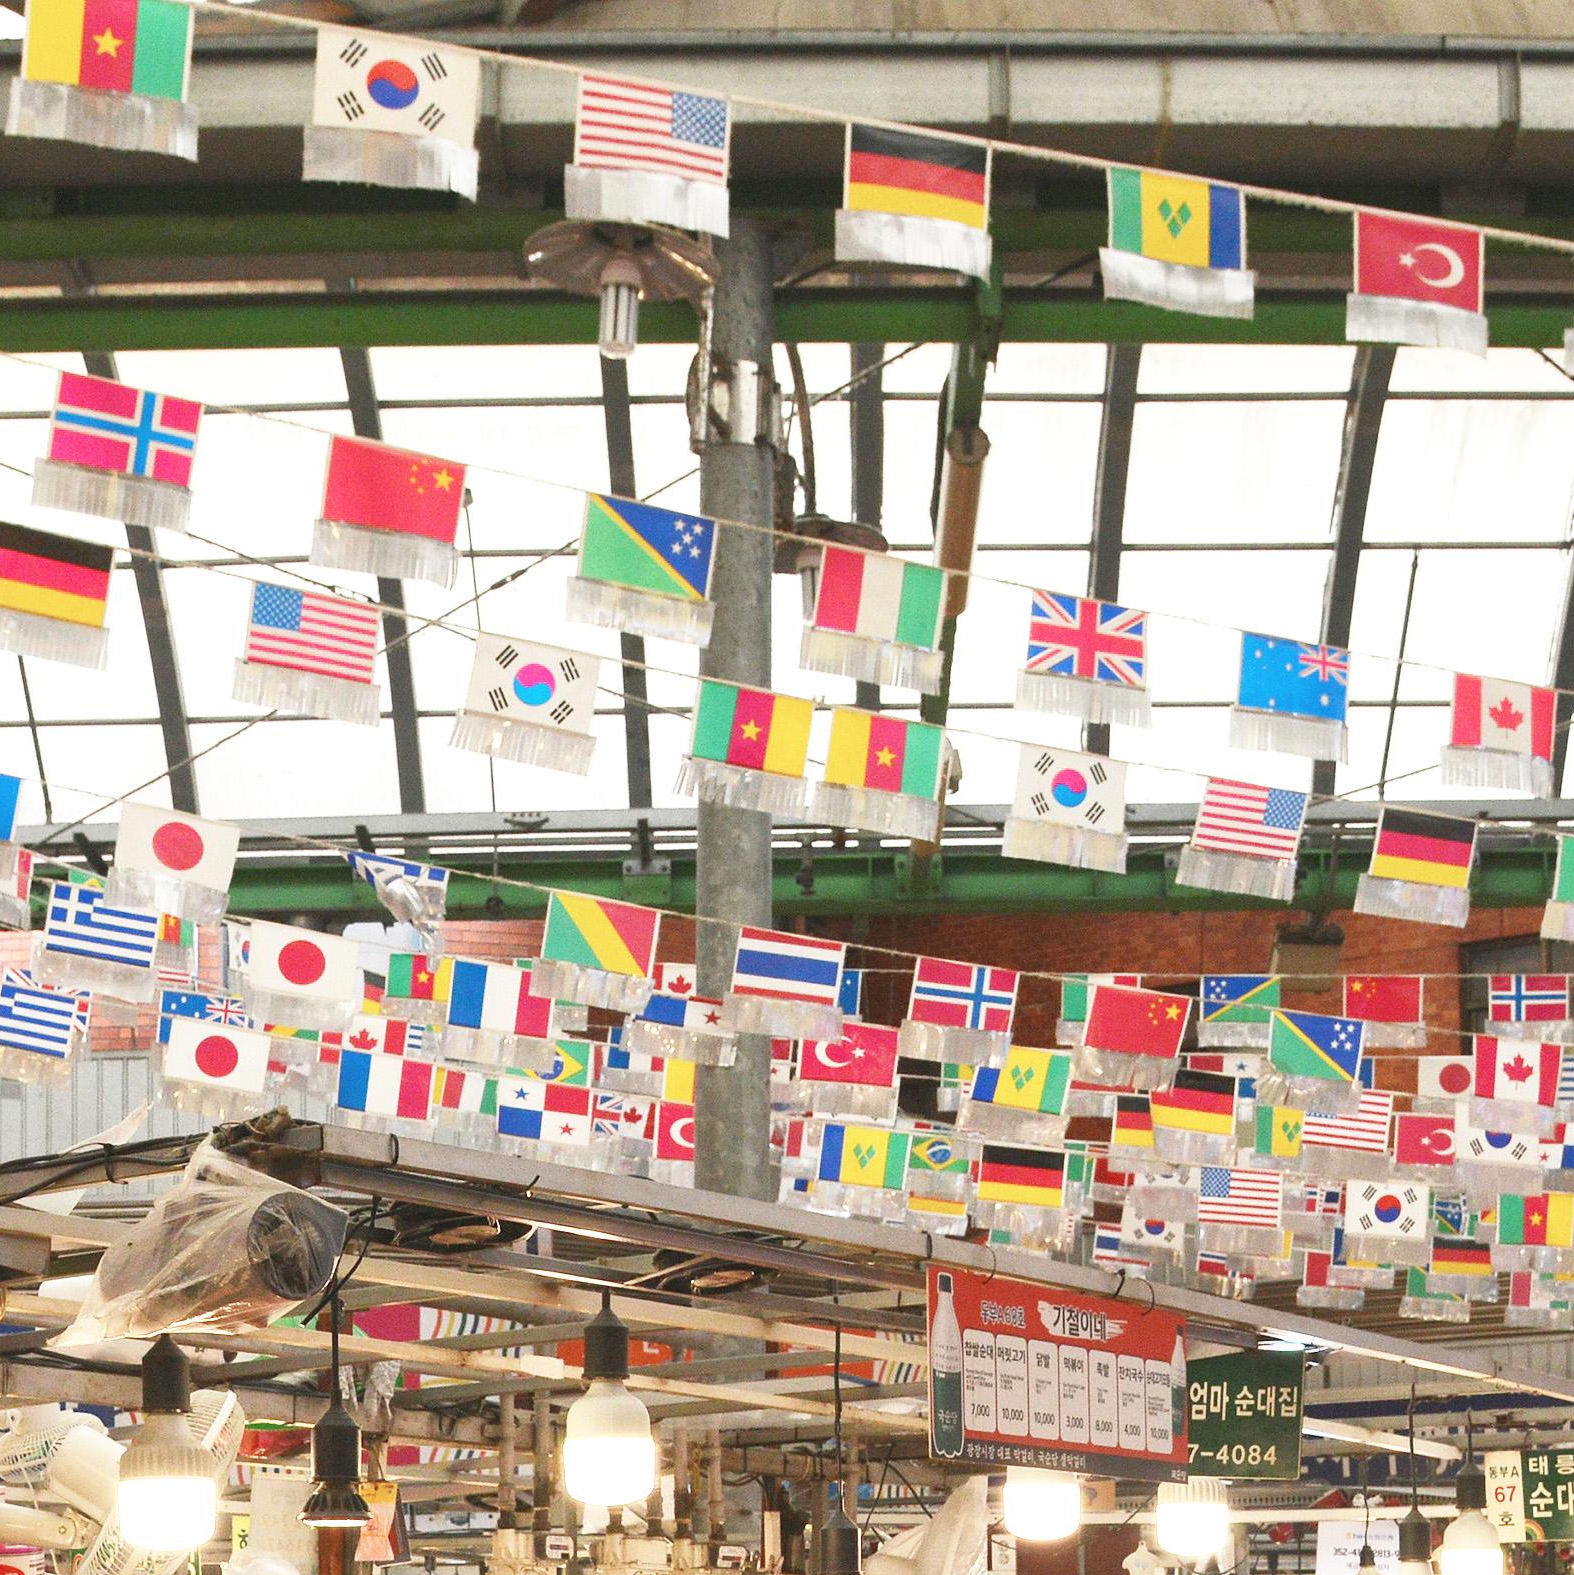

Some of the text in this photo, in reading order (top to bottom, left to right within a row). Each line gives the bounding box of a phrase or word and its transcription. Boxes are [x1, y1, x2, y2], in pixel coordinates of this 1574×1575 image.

[1053, 1306, 1106, 1341] 기철이네
[1190, 1381, 1230, 1421] 엄마
[1234, 1385, 1298, 1418] 순대집
[971, 1403, 990, 1417] 7,000
[1001, 1407, 1024, 1422] 10,000
[1033, 1412, 1056, 1426] 10,000
[1066, 1416, 1085, 1430] 3,000
[1095, 1420, 1113, 1433] 8,000
[1124, 1423, 1142, 1437] 4,000
[1488, 1465, 1520, 1479] 동부A
[1494, 1486, 1517, 1503] 67
[1498, 1511, 1516, 1527] 호
